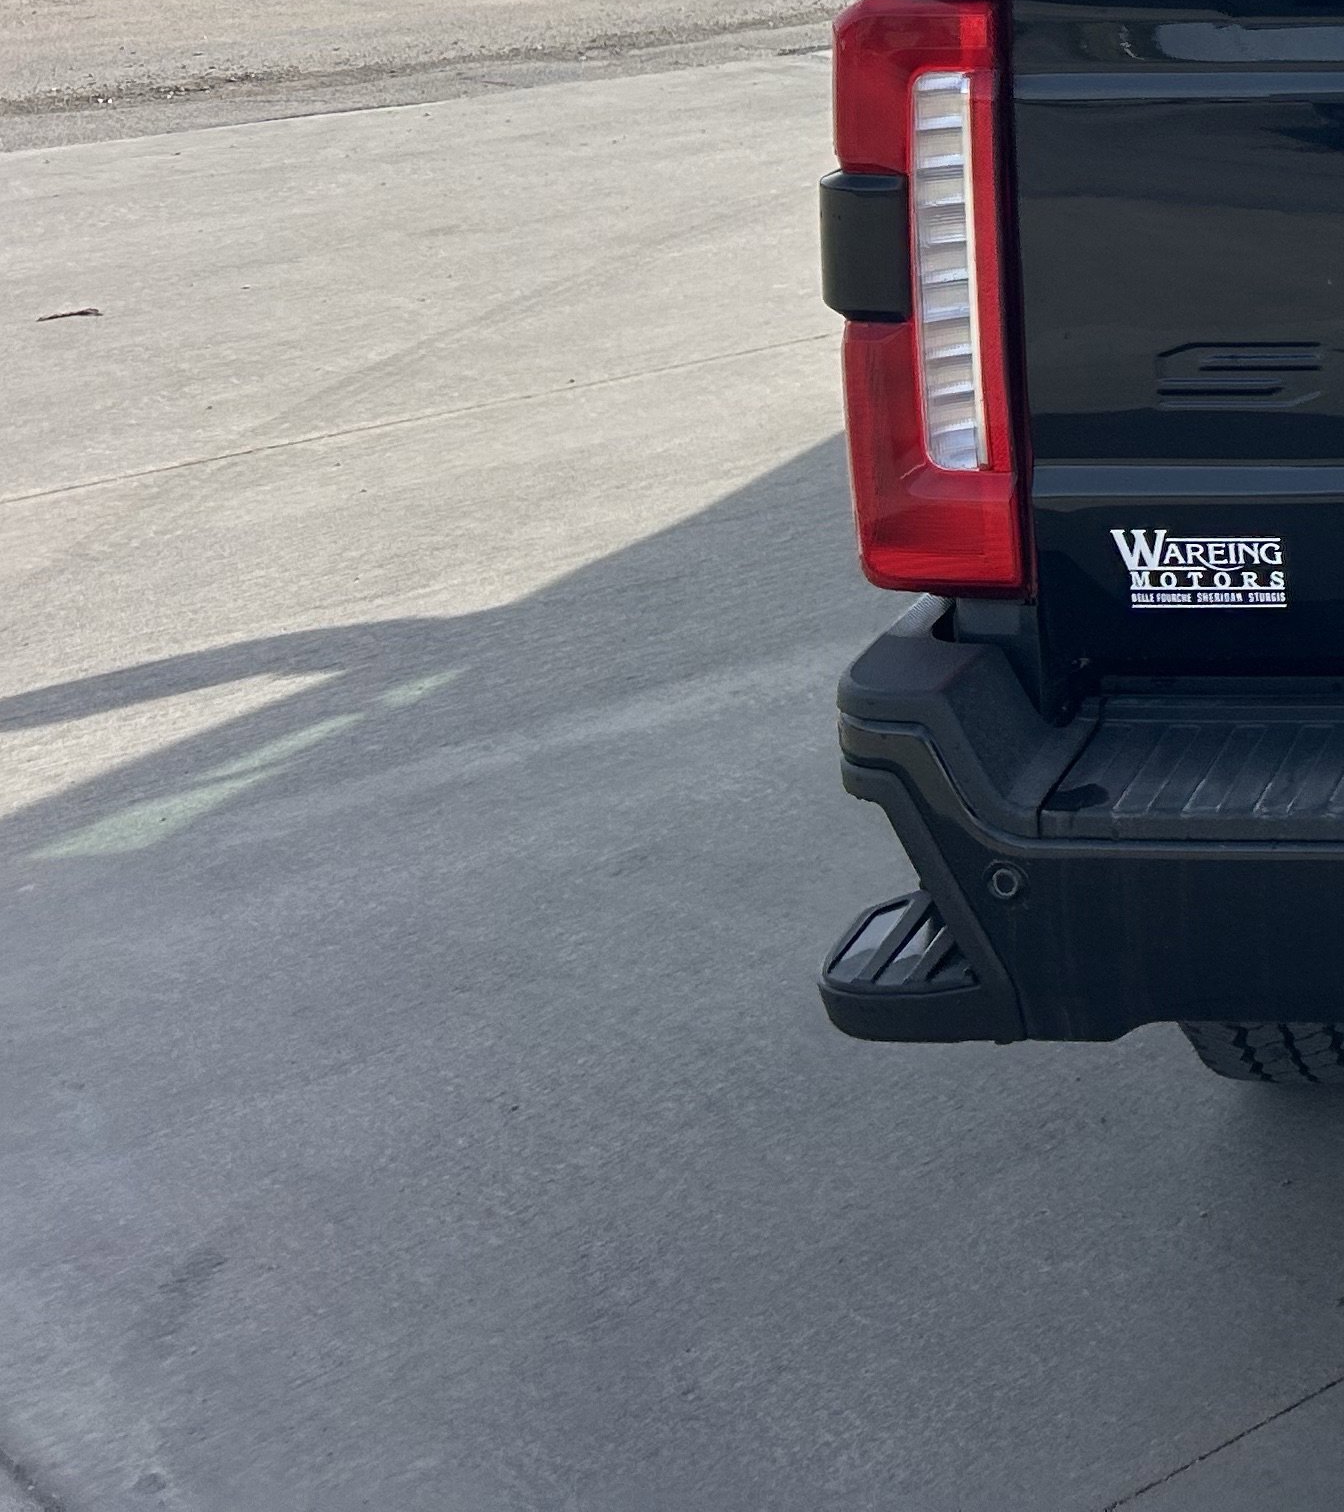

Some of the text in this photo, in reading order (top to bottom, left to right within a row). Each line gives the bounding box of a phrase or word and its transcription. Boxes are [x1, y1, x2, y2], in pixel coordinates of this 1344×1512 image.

[1110, 529, 1283, 570] WAREING
[1130, 571, 1285, 588] MOTORS
[1197, 592, 1243, 603] SHERIDAN
[1248, 592, 1286, 602] STURGIS
